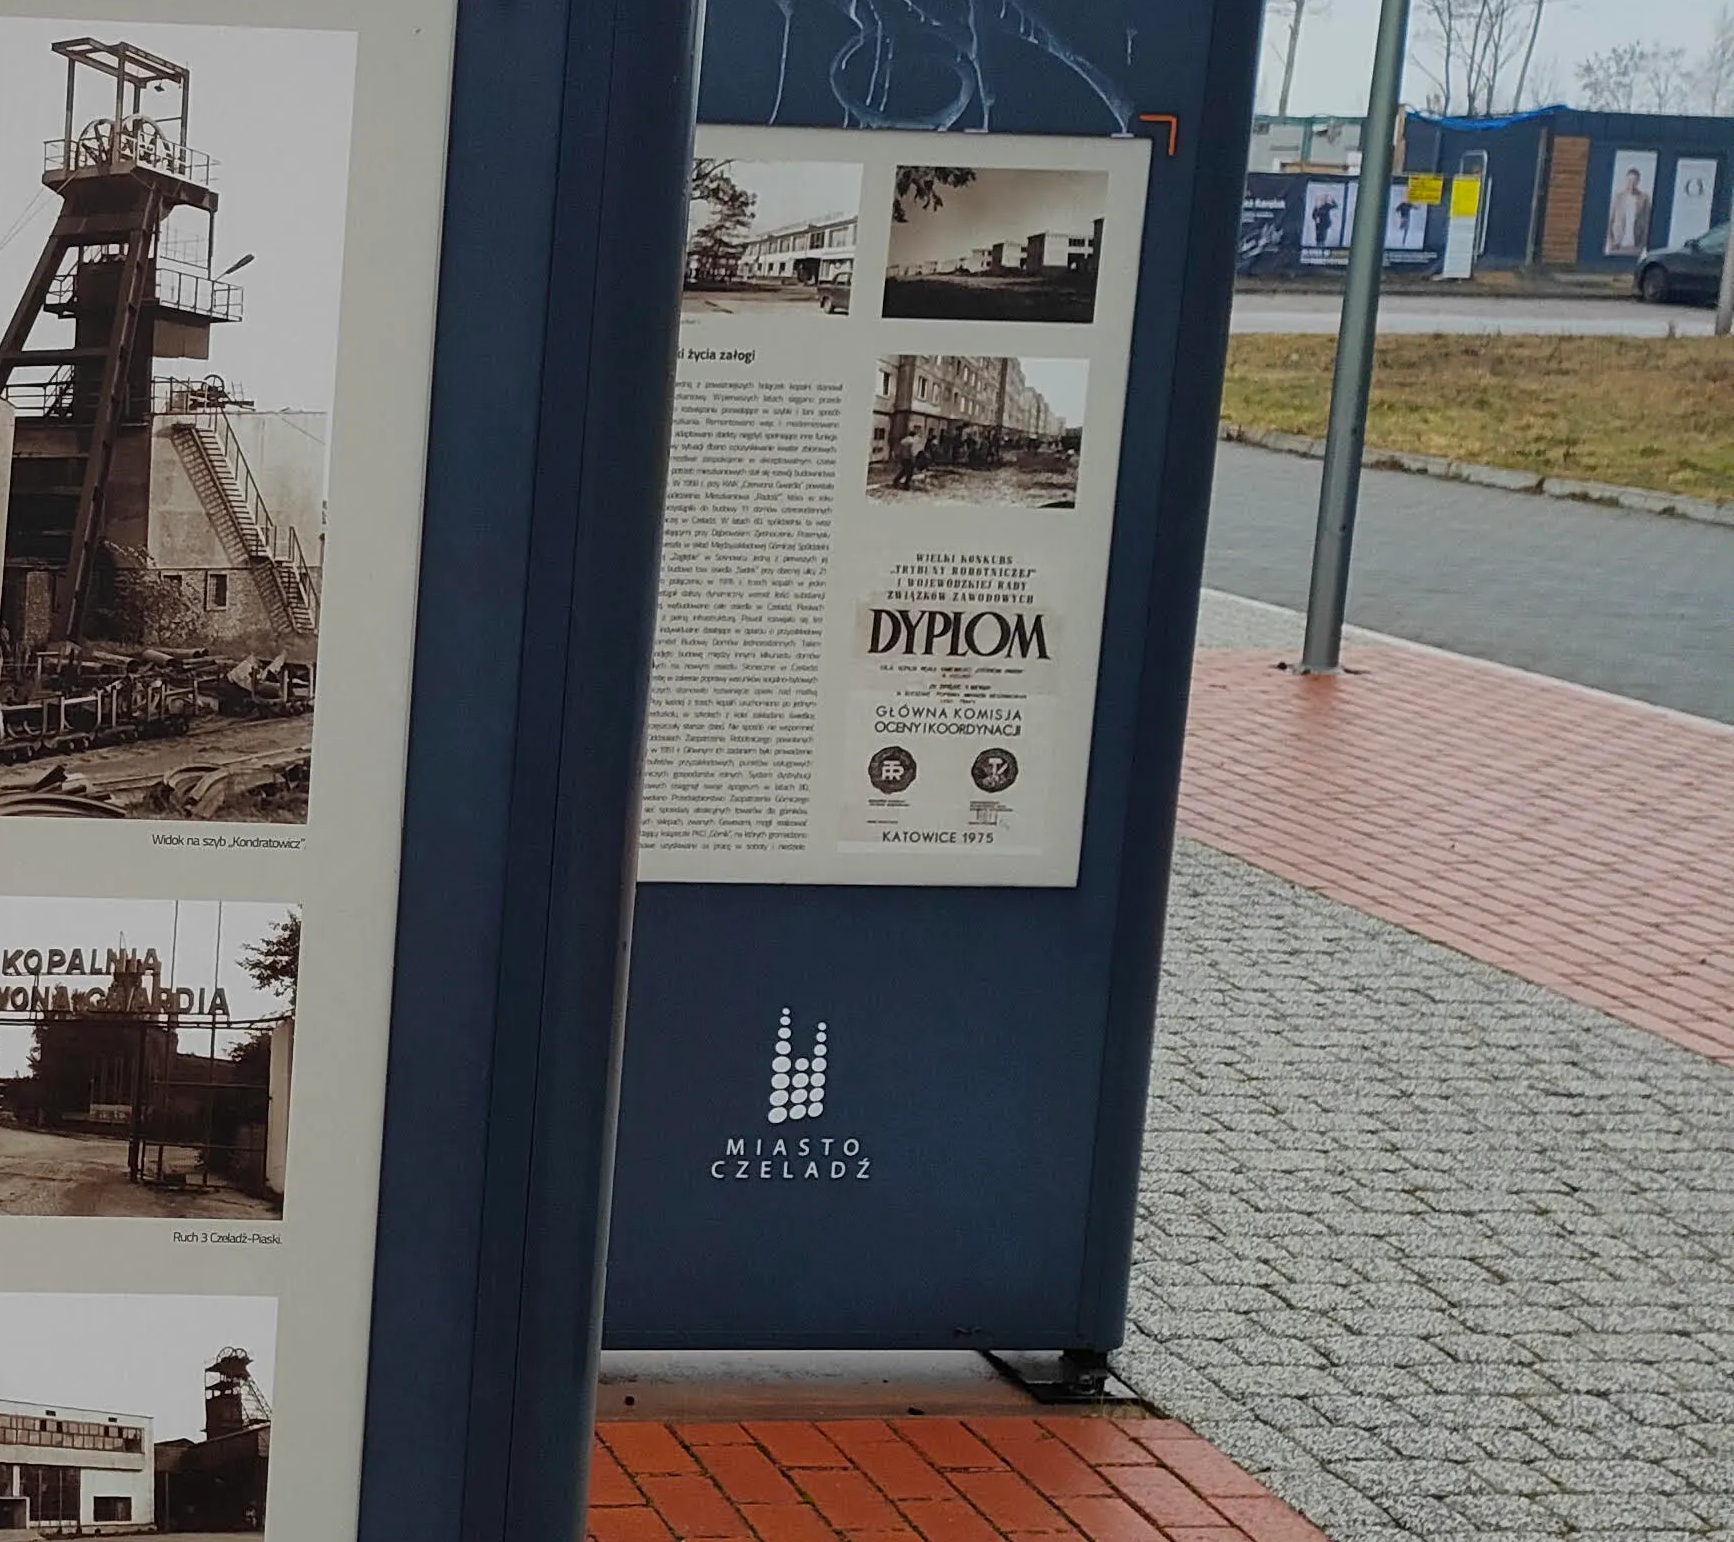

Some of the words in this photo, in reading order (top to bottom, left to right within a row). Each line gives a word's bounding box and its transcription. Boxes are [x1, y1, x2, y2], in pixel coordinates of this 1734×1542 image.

[688, 349, 716, 362] życia
[720, 349, 755, 364] załogi
[868, 609, 1050, 660] DYPLOM
[876, 704, 947, 719] GŁÓWNA
[954, 708, 1021, 721] KOMISJA
[875, 721, 921, 734] OCENY
[929, 722, 1021, 736] KOORDYNACJI
[152, 835, 184, 845] Widok
[187, 838, 200, 846] na
[203, 836, 226, 849] szyb
[883, 831, 957, 843] KATOWICE
[963, 833, 993, 843] 1975
[1, 947, 162, 976] KOPALNIA
[727, 1139, 859, 1156] MIASTO
[712, 1158, 870, 1178] CZELADŹ
[174, 1232, 198, 1242] Ruch
[201, 1233, 208, 1243] 3
[210, 1233, 281, 1244] Czeladź-Piaski.
